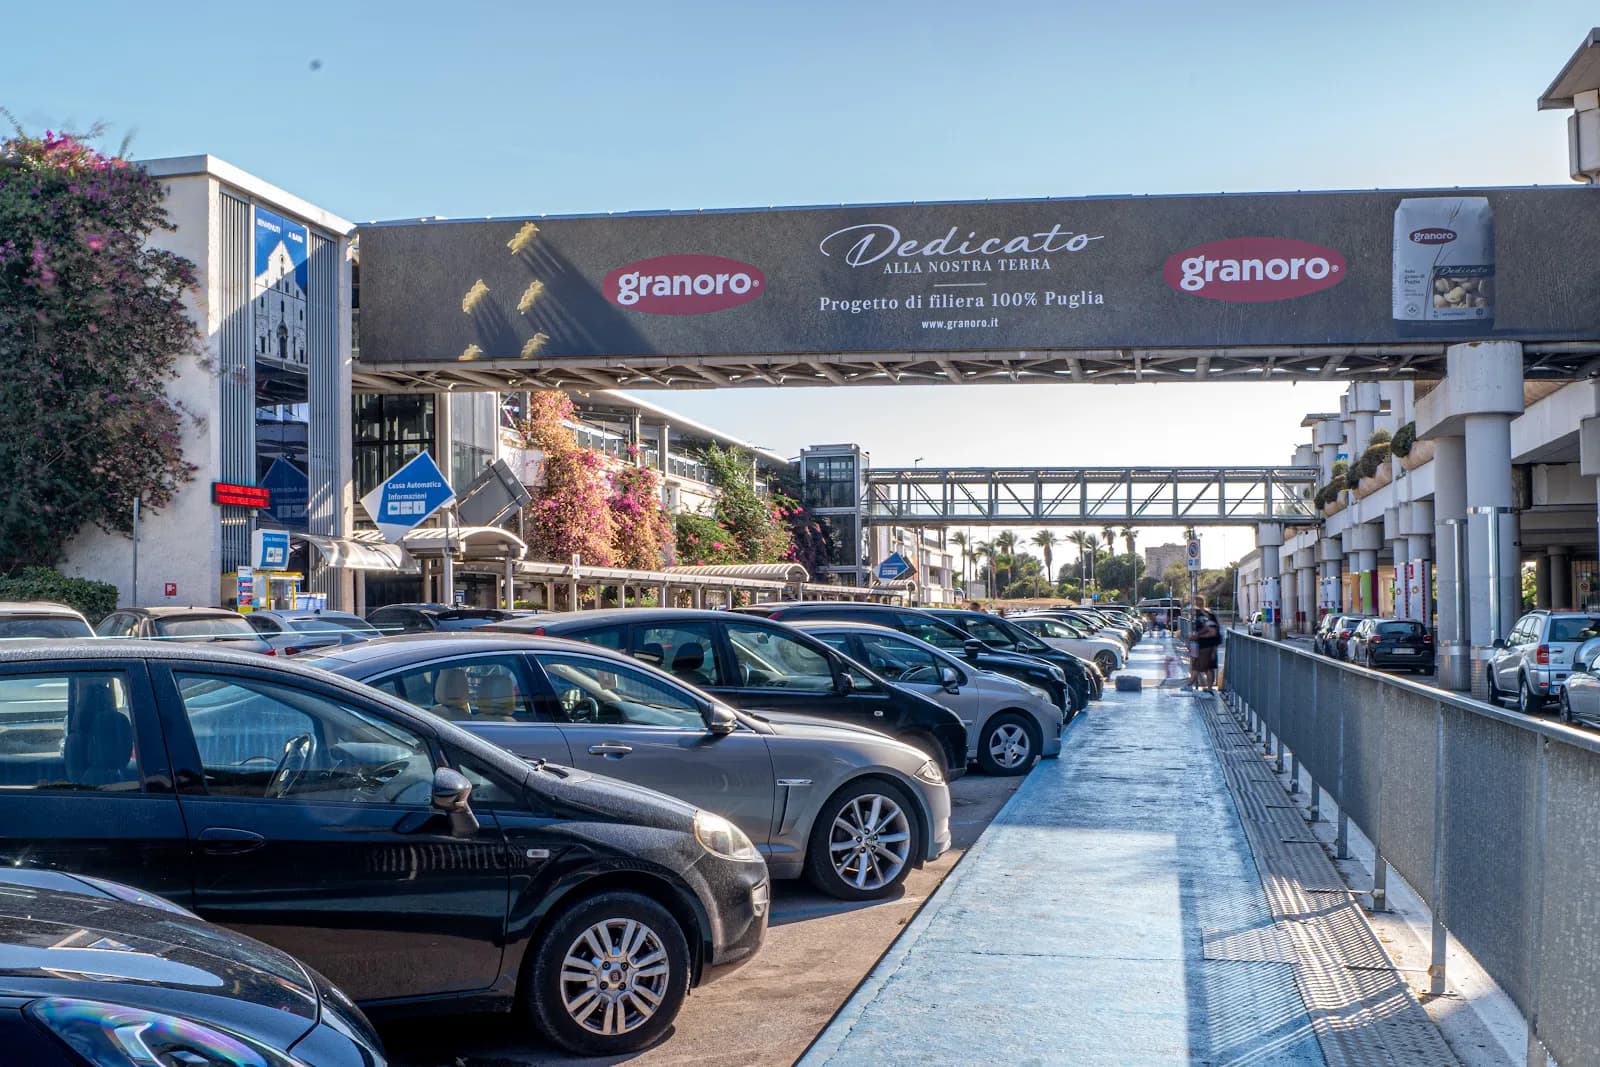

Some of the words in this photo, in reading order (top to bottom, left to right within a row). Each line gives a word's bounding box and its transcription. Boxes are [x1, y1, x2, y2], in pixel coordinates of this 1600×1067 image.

[820, 223, 1105, 268] Dedicato
[1414, 231, 1455, 242] granoro
[883, 262, 923, 274] ALLA
[928, 260, 992, 273] NOSTRA
[998, 258, 1051, 271] TERRA
[1180, 255, 1330, 291] granoro
[617, 272, 751, 305] granoro
[820, 297, 899, 314] Progetto
[905, 294, 922, 309] di
[929, 294, 985, 309] filiera
[991, 292, 1038, 307] 100%
[1044, 290, 1105, 309] Puglia
[921, 317, 999, 330] www.granoro.it
[387, 482, 406, 490] Cassa
[406, 480, 442, 489] Automatica
